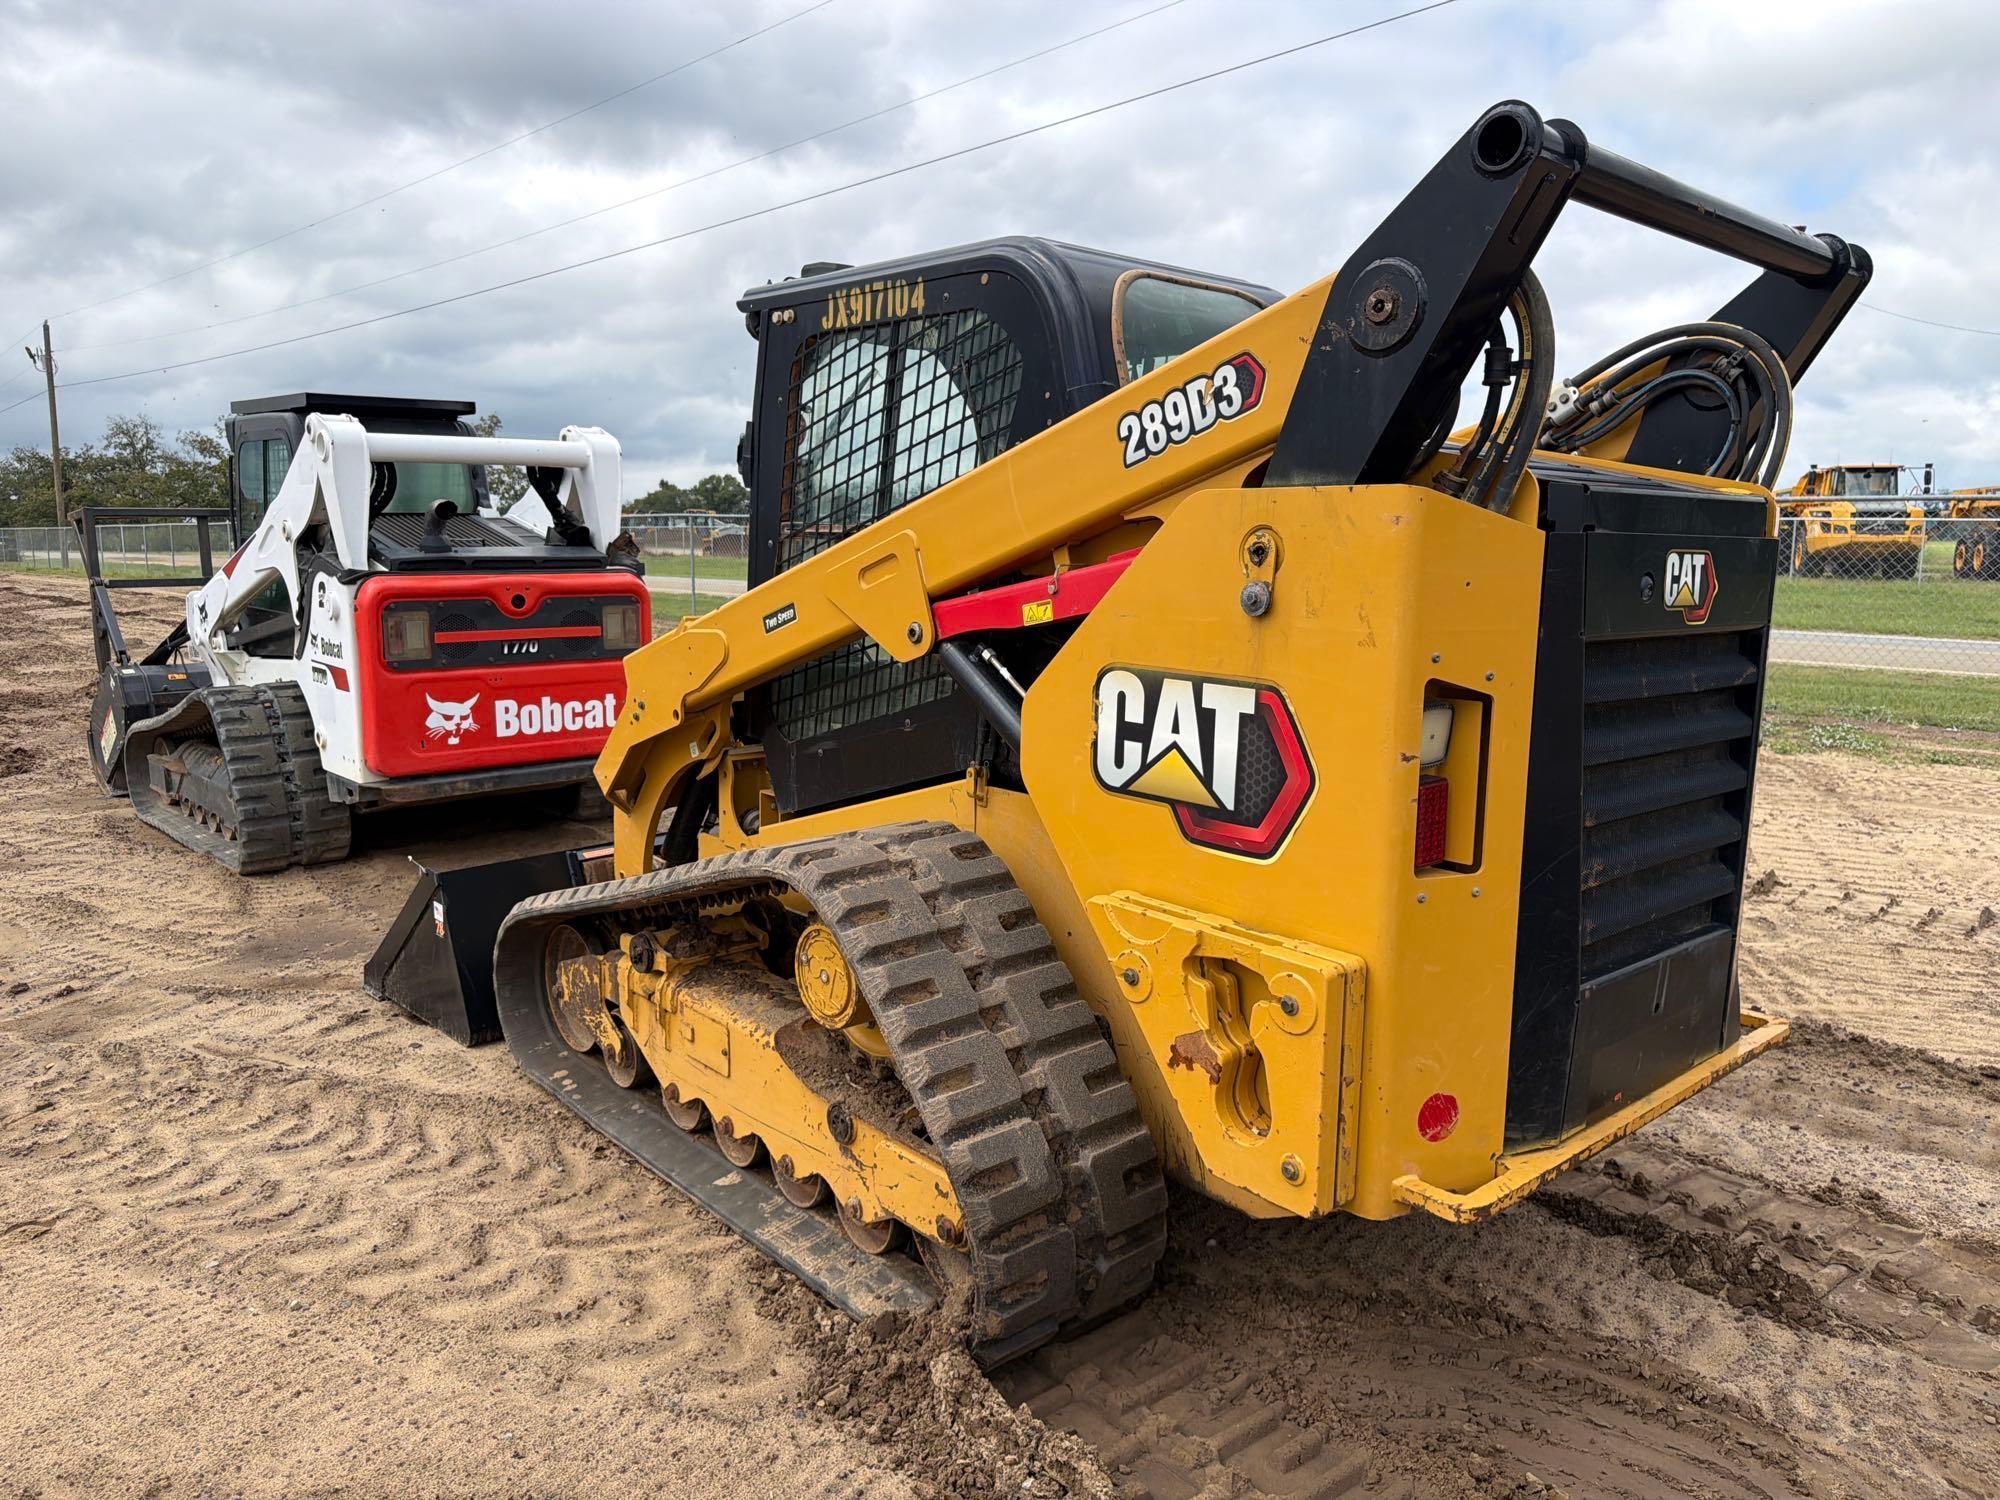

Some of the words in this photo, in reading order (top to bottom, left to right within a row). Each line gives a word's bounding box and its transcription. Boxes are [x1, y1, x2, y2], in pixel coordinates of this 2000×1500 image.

[822, 276, 925, 330] JX917104
[1119, 364, 1243, 465] 289D3
[1665, 552, 1706, 607] CAT
[321, 637, 344, 660] Bobcat
[502, 640, 539, 655] T770
[495, 693, 617, 738] Bobcat
[1097, 669, 1256, 812] CAT
